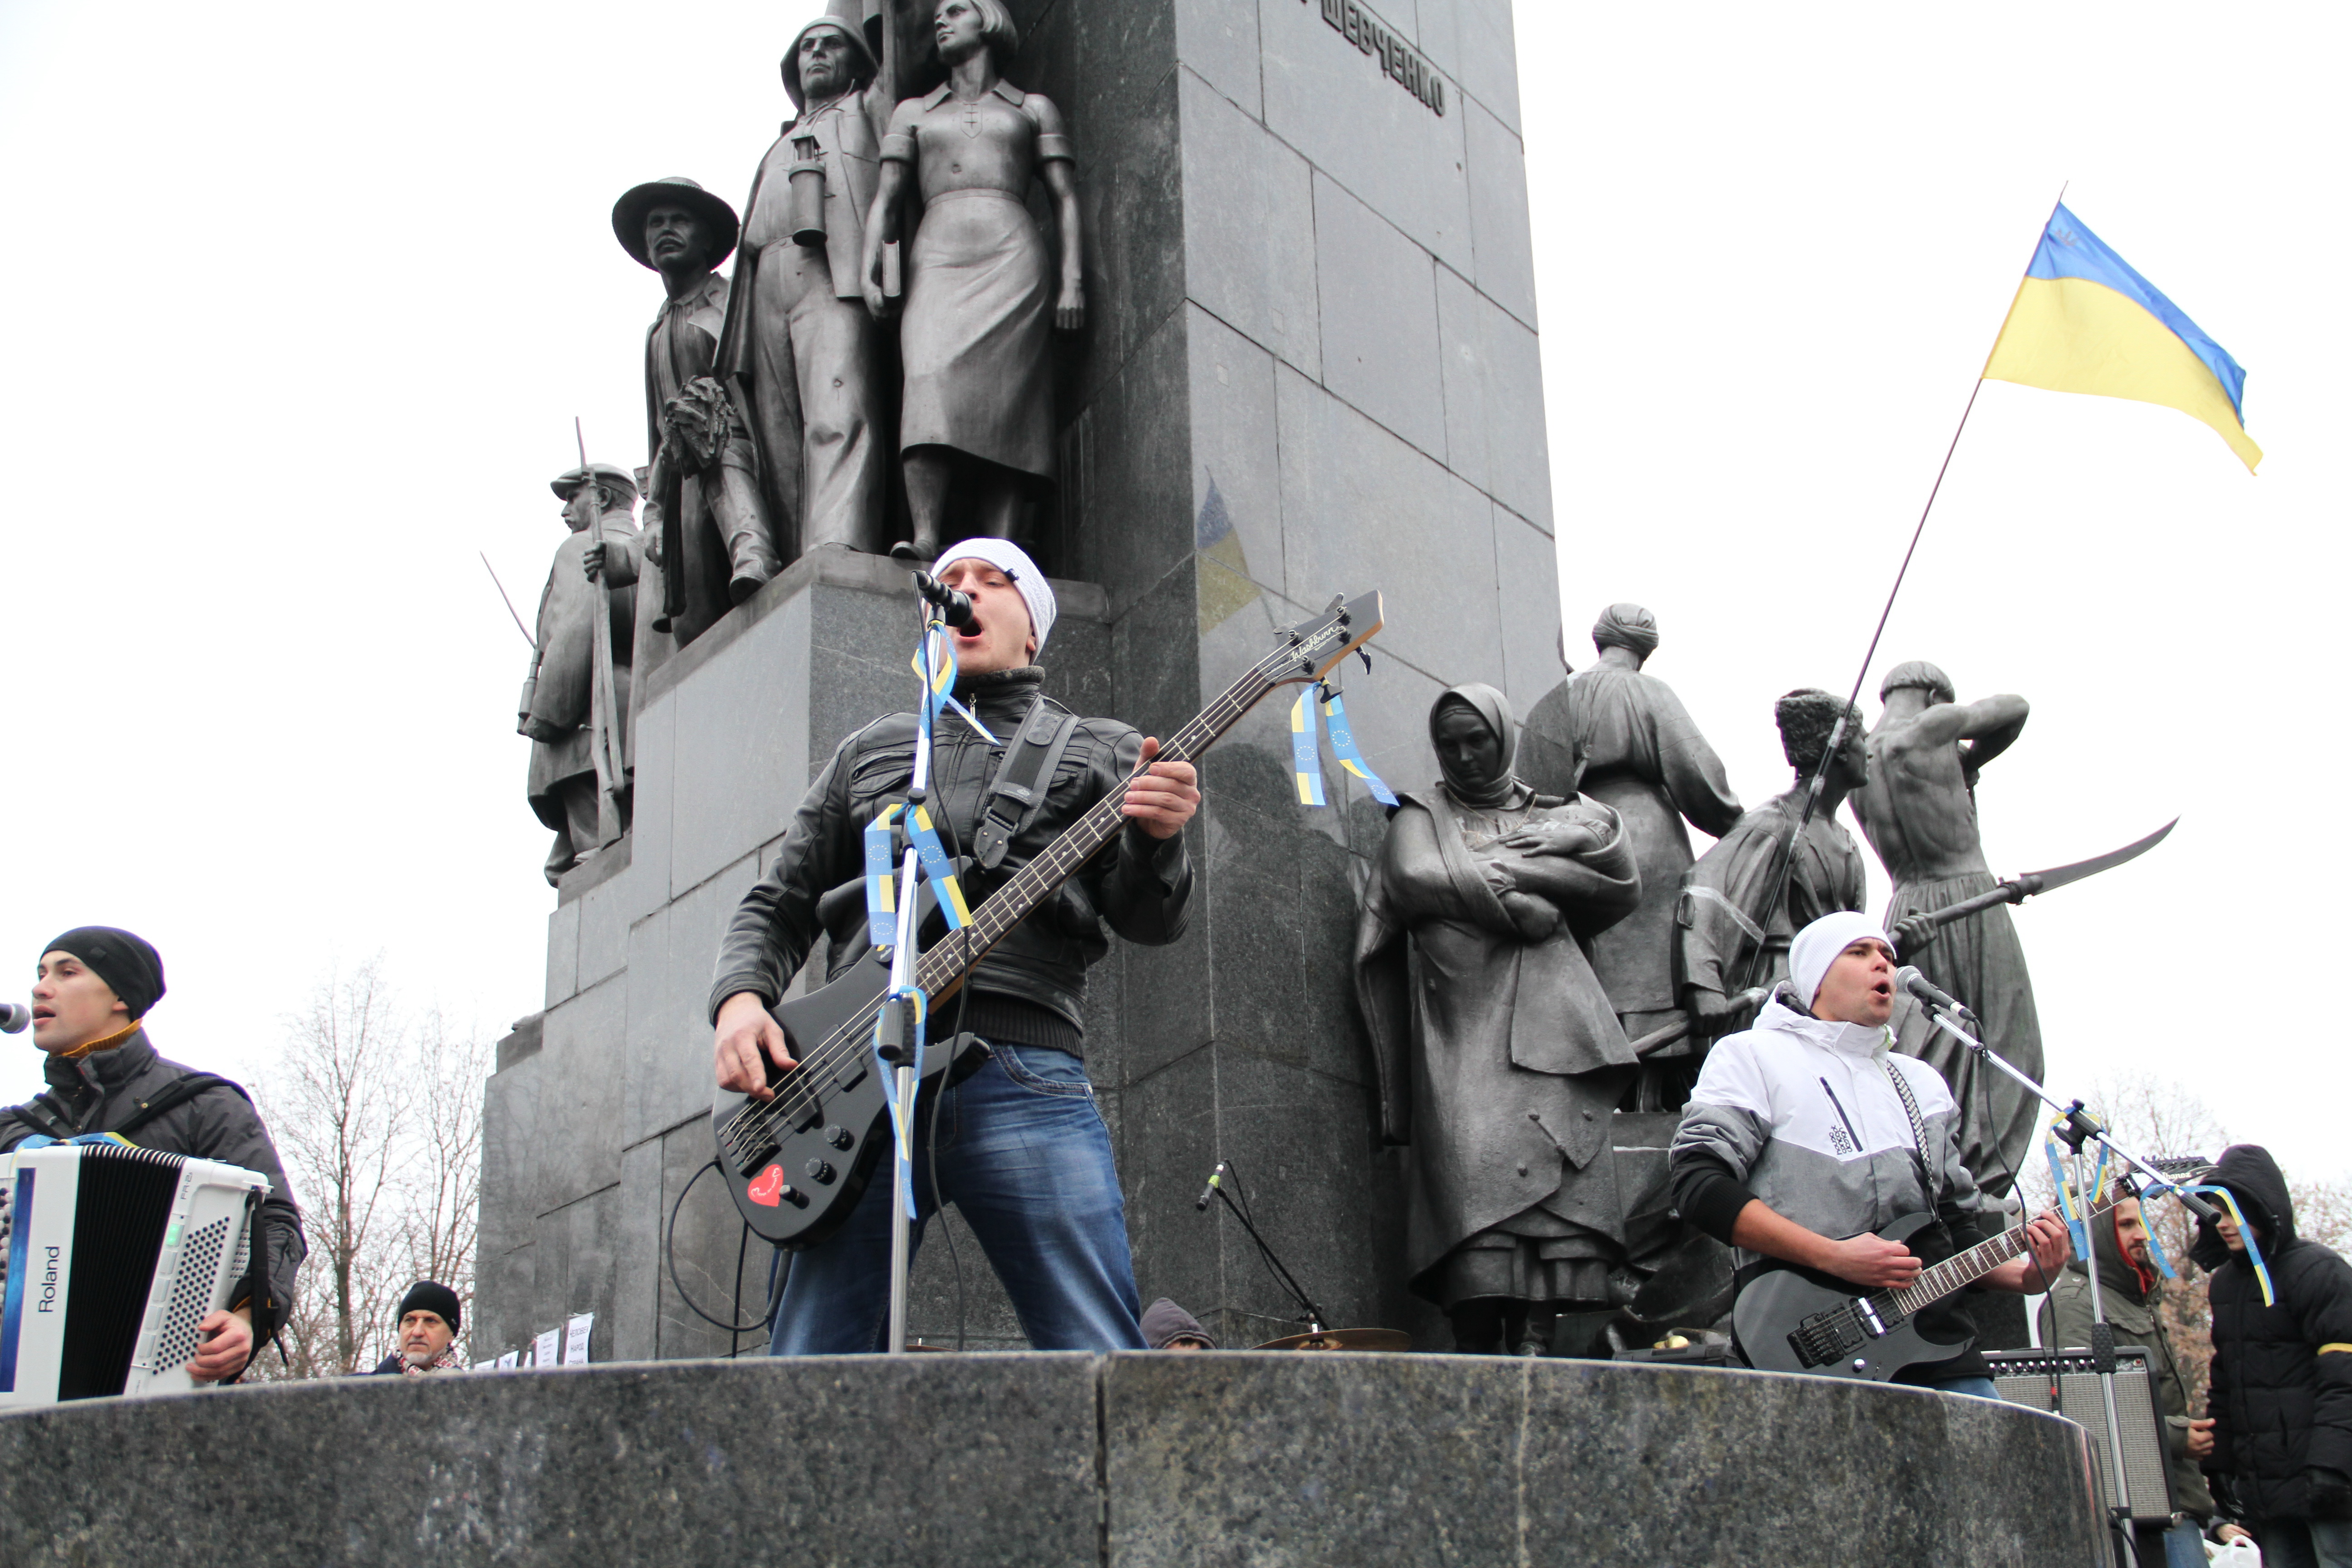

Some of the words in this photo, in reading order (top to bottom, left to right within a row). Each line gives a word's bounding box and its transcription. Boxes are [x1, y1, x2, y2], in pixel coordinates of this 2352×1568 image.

[1321, 0, 1446, 117] ШЕВЧЕНКО
[1290, 625, 1341, 662] Washburn
[39, 1246, 60, 1312] Roland
[570, 1326, 590, 1338] ЧЕЛОВЕК
[570, 1343, 584, 1353] НАРОД
